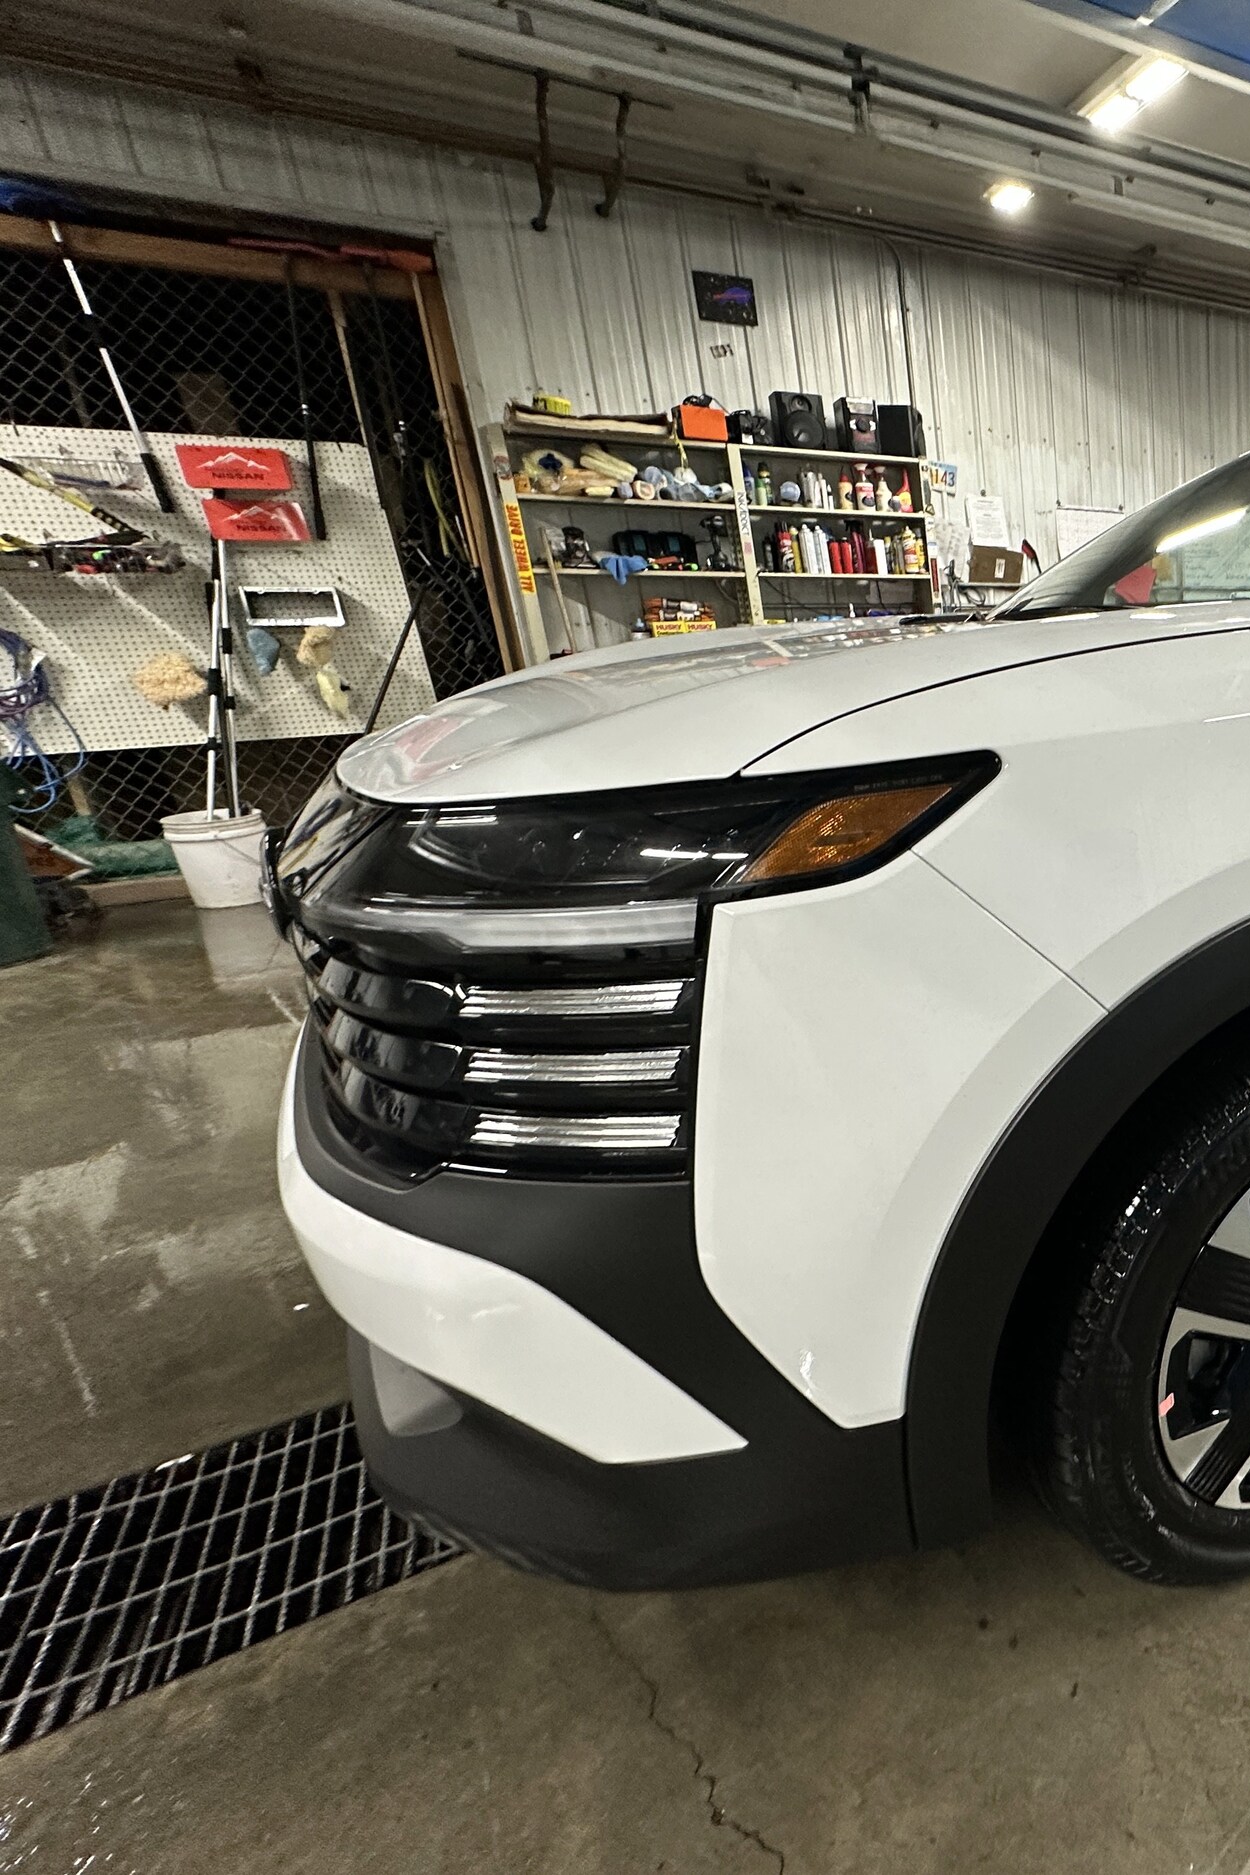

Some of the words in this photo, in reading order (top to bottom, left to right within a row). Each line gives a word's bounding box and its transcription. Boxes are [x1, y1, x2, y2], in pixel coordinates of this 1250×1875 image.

[212, 472, 265, 480] NISSAN
[505, 504, 524, 536] DRIVE
[513, 538, 530, 572] WHEEL
[520, 575, 535, 593] ALL
[687, 623, 713, 631] HUSKY
